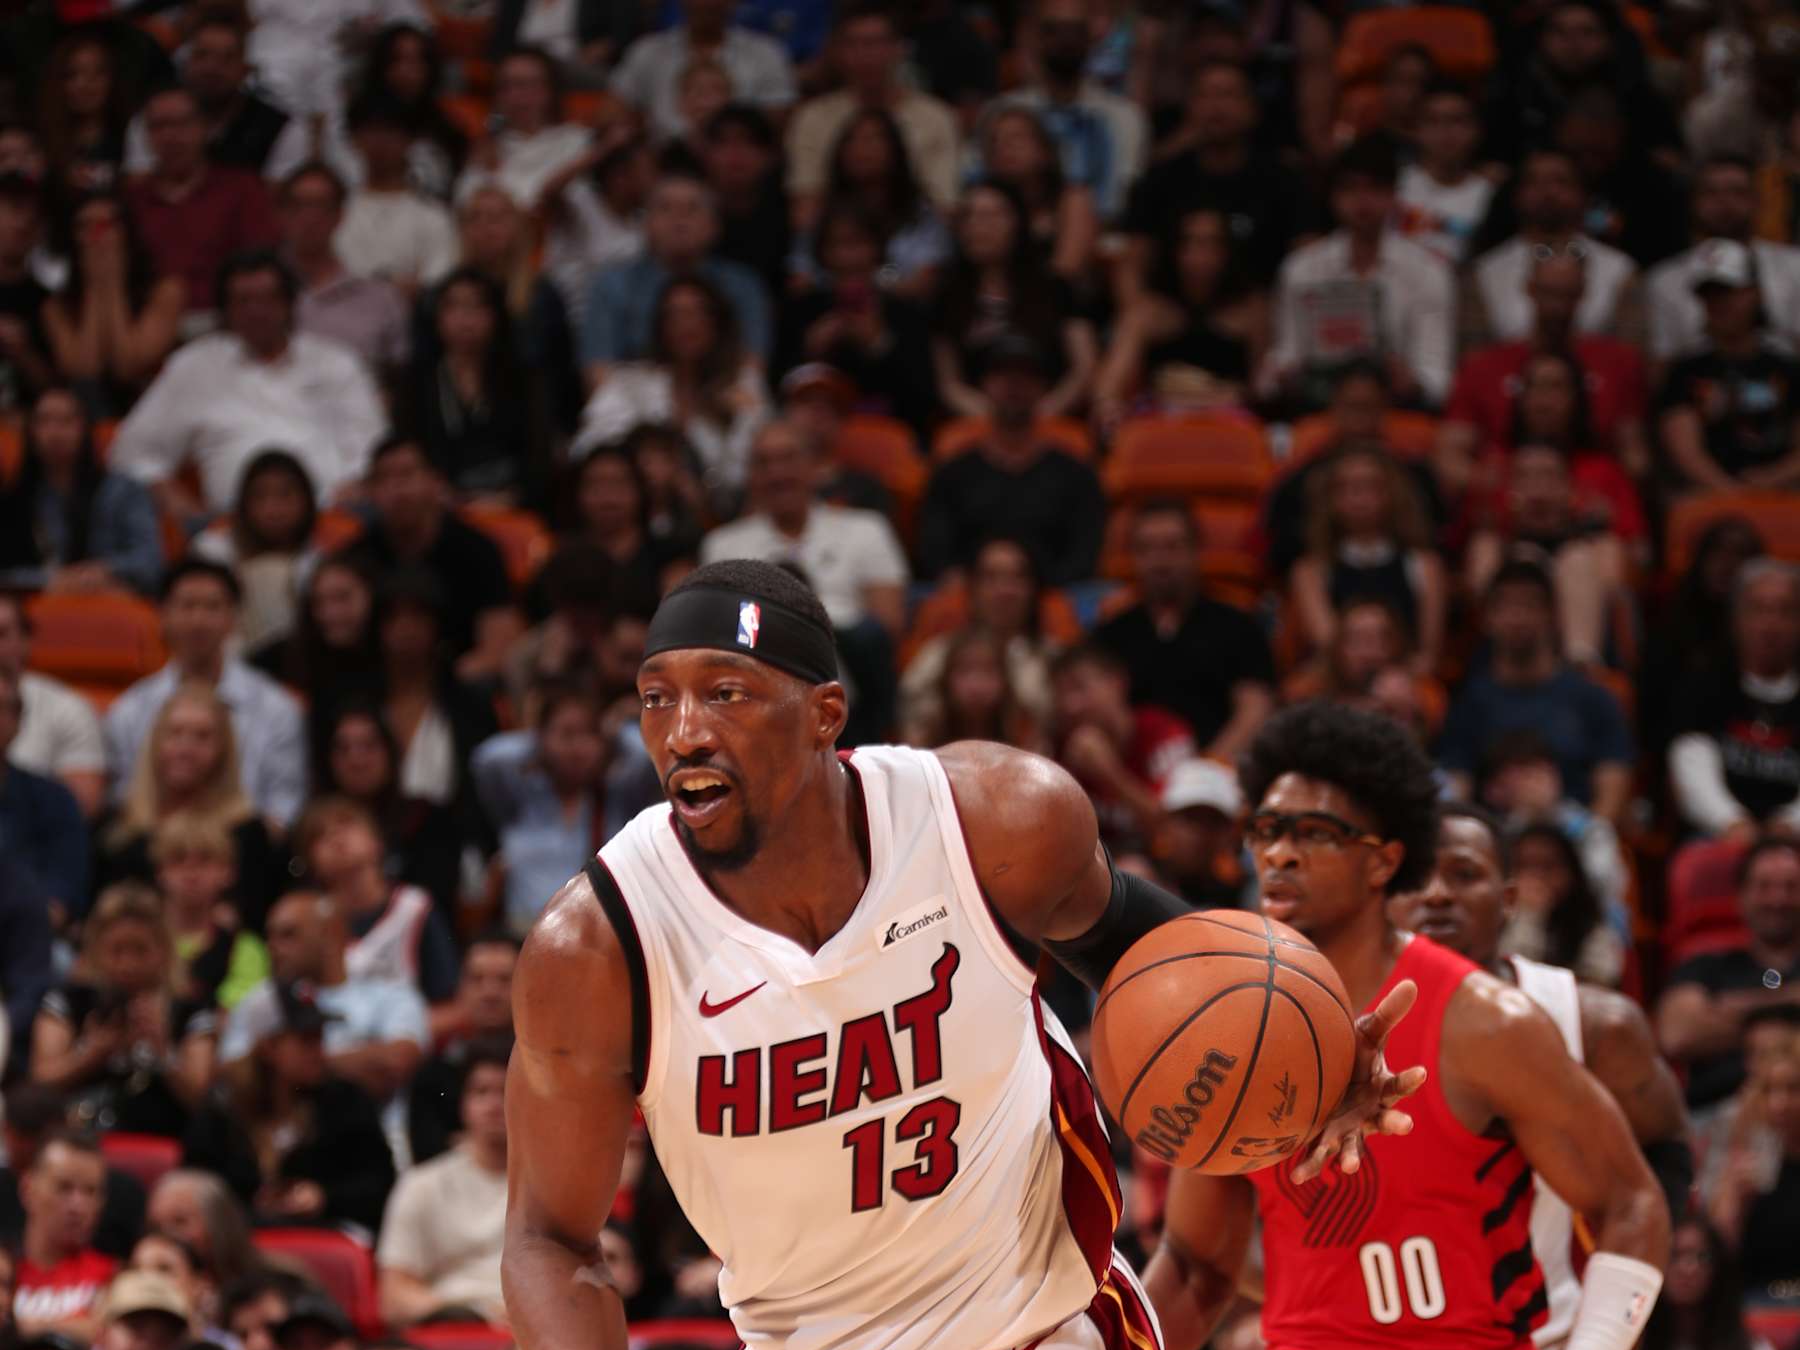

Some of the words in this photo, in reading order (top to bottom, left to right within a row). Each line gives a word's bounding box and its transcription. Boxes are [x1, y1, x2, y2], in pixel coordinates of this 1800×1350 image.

[896, 906, 948, 939] Carnival
[695, 941, 961, 1138] HEAT
[842, 1095, 962, 1214] 13
[1359, 1235, 1447, 1325] 00
